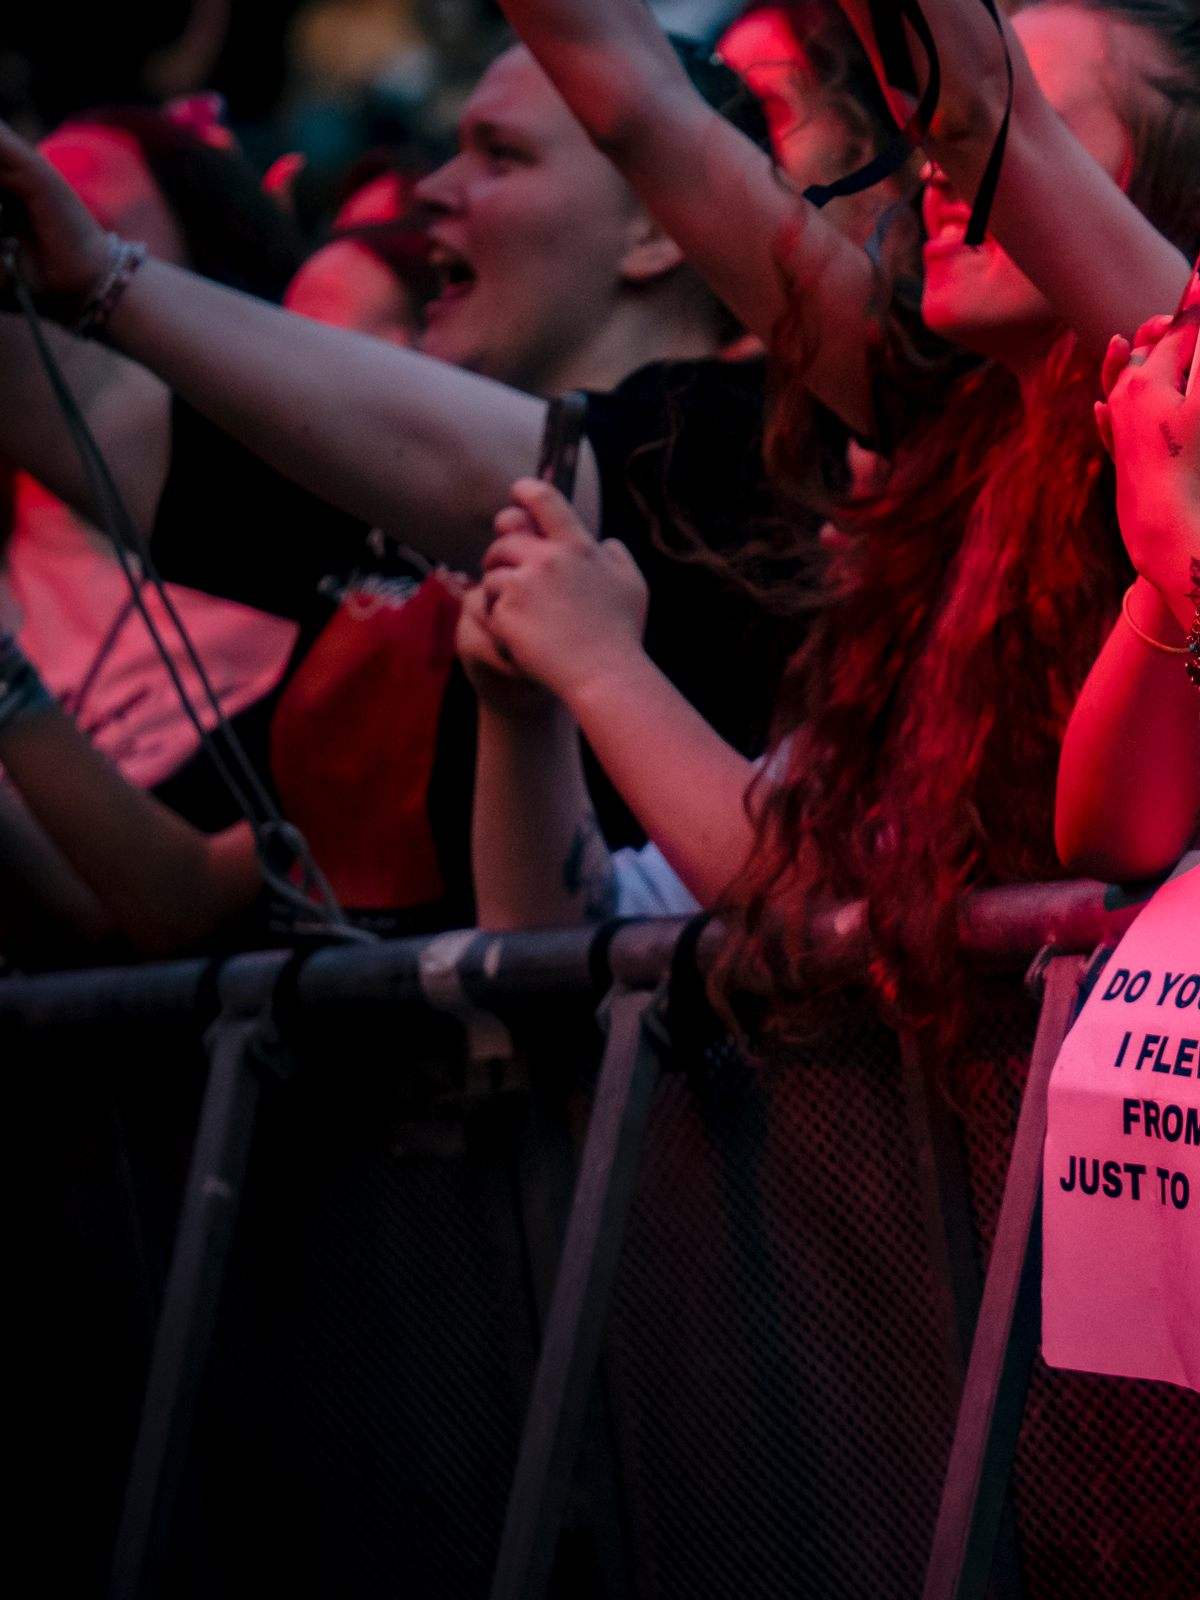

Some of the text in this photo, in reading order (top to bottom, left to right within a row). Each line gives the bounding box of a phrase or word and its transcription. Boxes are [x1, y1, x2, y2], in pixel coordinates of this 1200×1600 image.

[1102, 969, 1152, 1003] DO
[1114, 1032, 1132, 1068] I
[1059, 1155, 1147, 1201] JUST
[1156, 1167, 1190, 1210] TO
